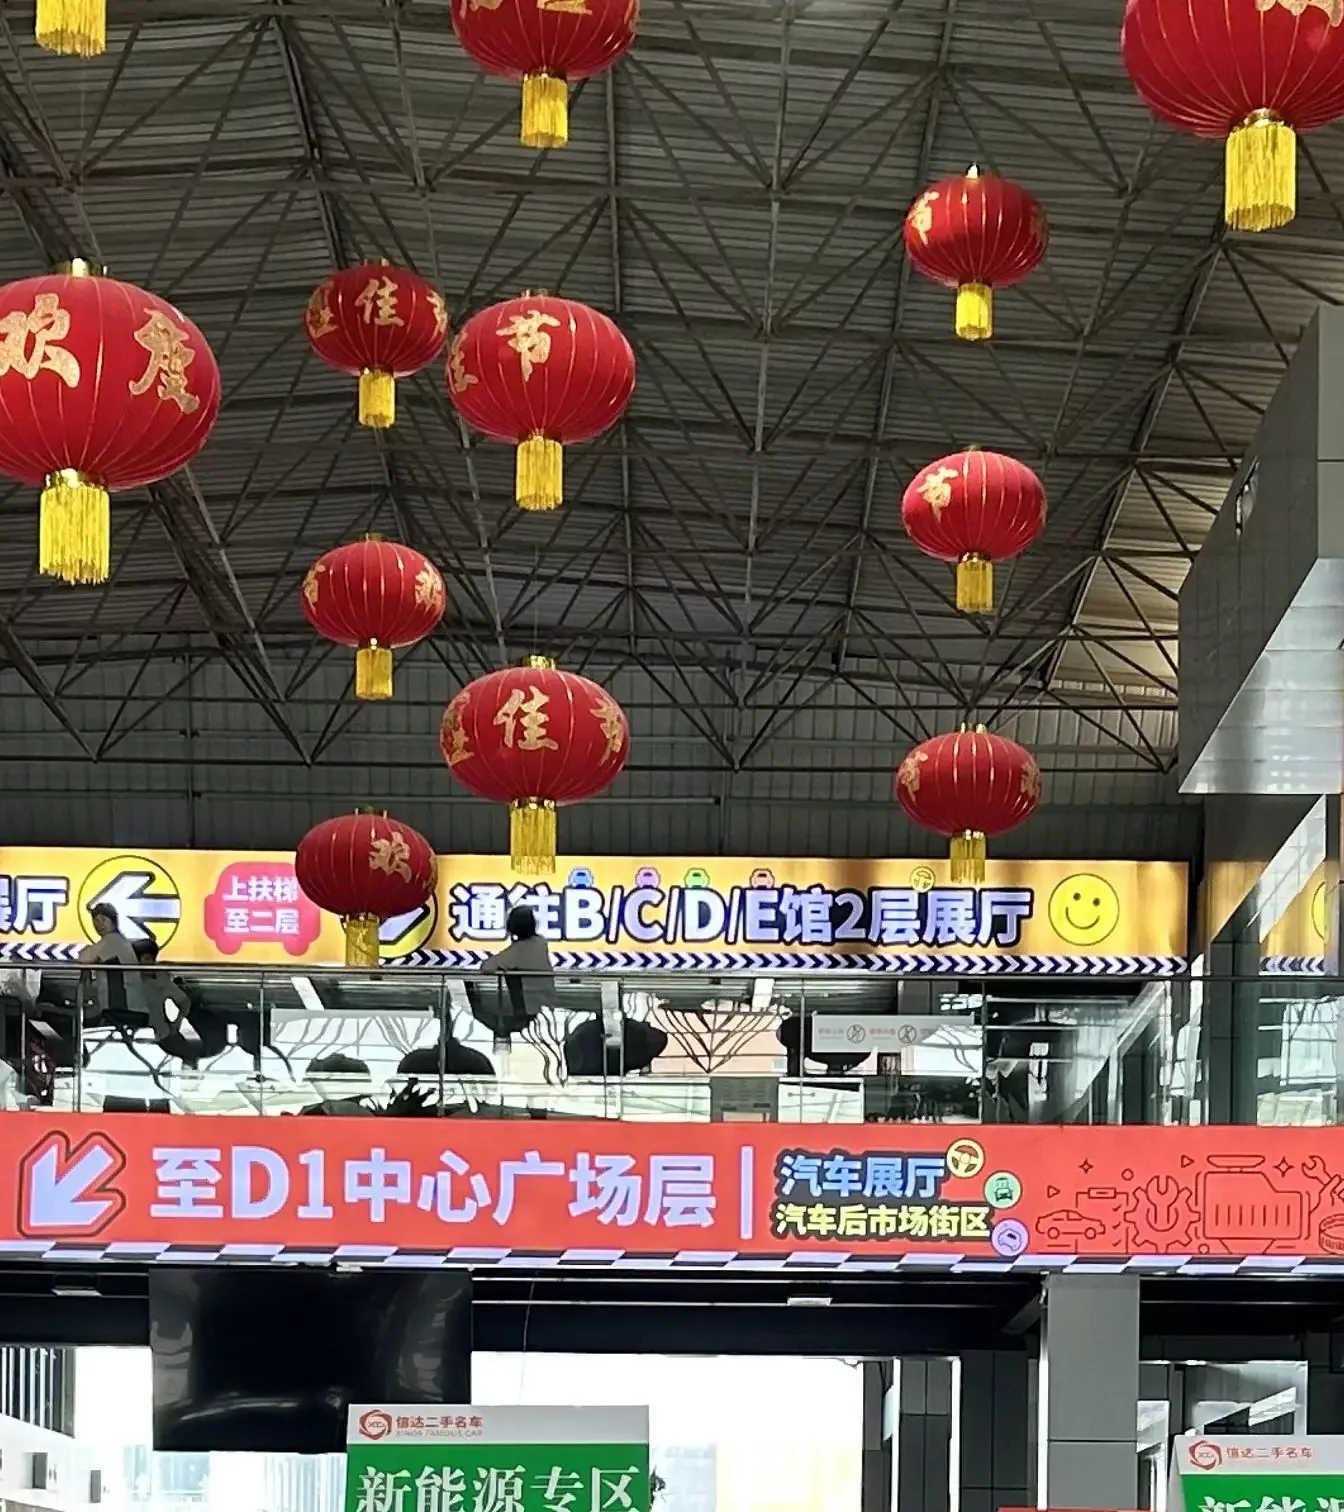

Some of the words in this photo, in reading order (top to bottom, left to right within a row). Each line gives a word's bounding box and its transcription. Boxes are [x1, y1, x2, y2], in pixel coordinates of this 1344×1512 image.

[223, 875, 298, 903] 上扶梯
[223, 907, 299, 935] 至二层
[149, 1145, 718, 1228] 至D1中心广场层
[780, 1154, 945, 1200] 汽车展厅
[775, 1203, 993, 1238] 汽车后市场街区
[395, 1415, 484, 1429] 信达二手名车
[1226, 1446, 1313, 1459] 信达二手名车
